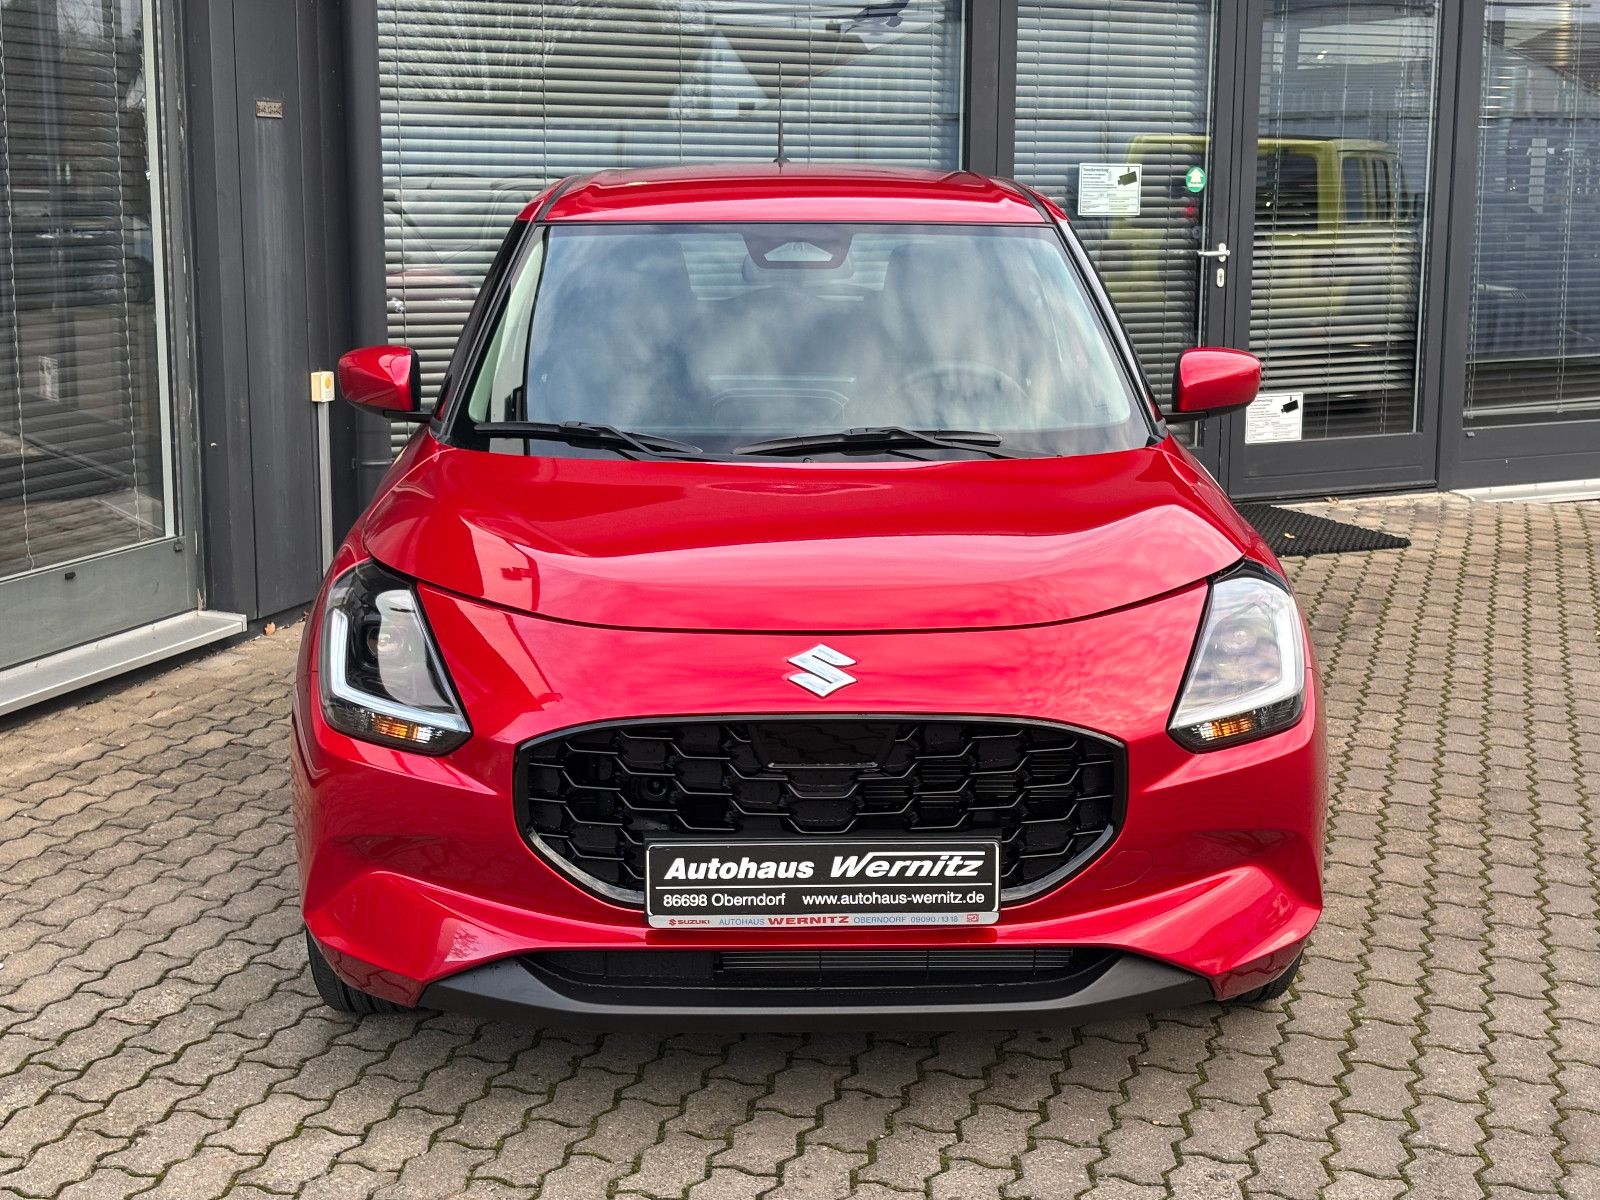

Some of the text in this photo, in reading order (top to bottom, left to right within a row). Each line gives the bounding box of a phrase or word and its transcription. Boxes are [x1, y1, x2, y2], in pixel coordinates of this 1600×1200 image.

[664, 851, 985, 880] Autohaus Wernitz
[663, 891, 985, 907] 86698 Oberndorf www.autohaus-wernitz.de
[719, 918, 765, 926] AUTOHAUS
[768, 916, 849, 925] WERNITZ
[853, 916, 906, 924] OBERNDORF
